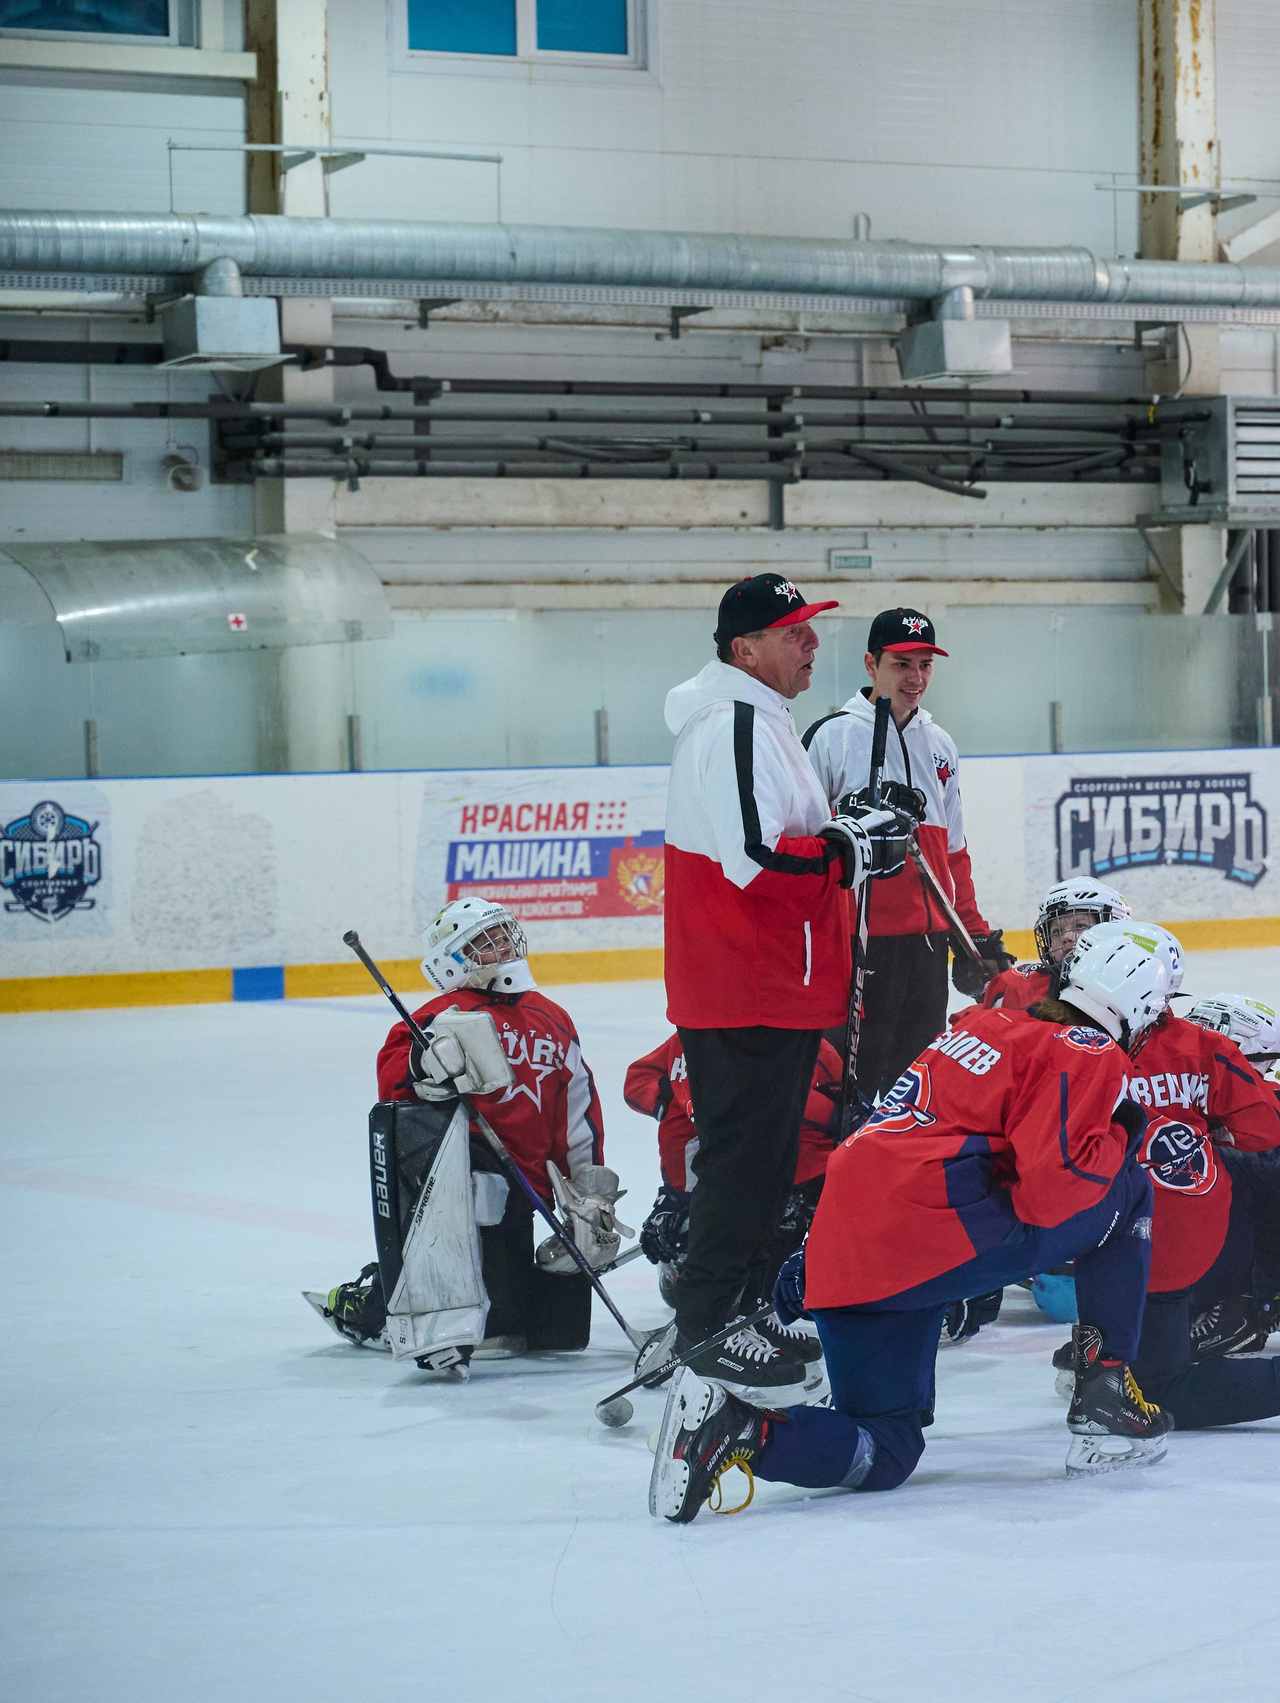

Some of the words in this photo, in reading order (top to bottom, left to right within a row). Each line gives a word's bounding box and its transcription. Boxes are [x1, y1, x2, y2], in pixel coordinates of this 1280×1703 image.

[460, 802, 590, 834] КРАСНАЯ
[1060, 791, 1265, 882] СИБИРЬ
[454, 840, 592, 881] МАШИНА
[1234, 1010, 1258, 1026] BAUER
[373, 1131, 390, 1219] BAUER
[415, 1176, 436, 1227] SUPREME
[720, 1358, 742, 1371] BAUER
